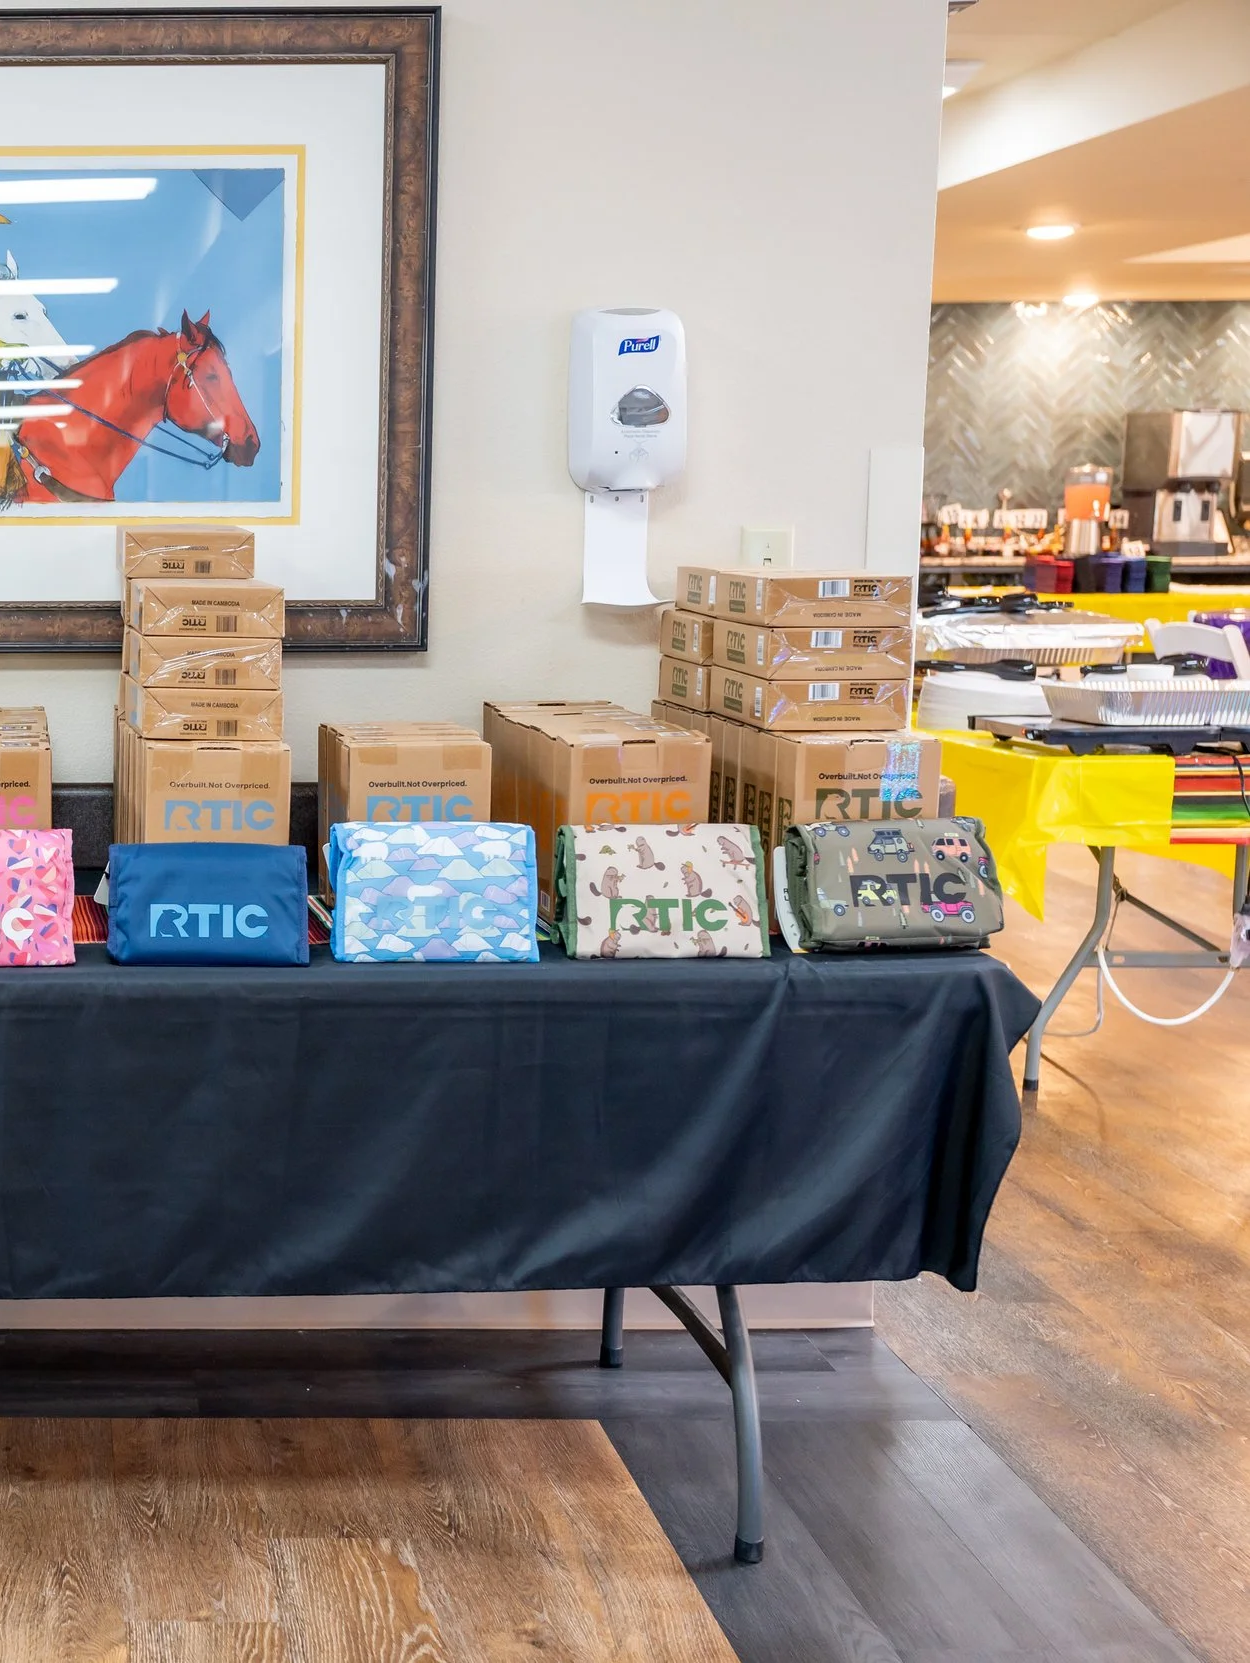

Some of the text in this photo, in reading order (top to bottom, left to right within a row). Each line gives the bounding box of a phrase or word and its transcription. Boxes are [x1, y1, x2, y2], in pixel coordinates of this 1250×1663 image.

[624, 338, 656, 352] Purell
[162, 561, 185, 570] RTIC
[853, 584, 878, 593] RTIC
[213, 600, 241, 608] CAMBODIA
[182, 618, 207, 627] RTIC
[853, 635, 877, 643] RTIC
[850, 687, 874, 695] RTIC
[182, 723, 208, 732] RTIC
[421, 780, 468, 789] Overpriced.
[642, 775, 688, 785] Overpriced.
[224, 781, 271, 790] Overpriced.
[585, 789, 693, 824] RTIC
[815, 787, 924, 820] RTIC
[366, 795, 475, 822] RTIC
[164, 799, 275, 832] RTIC
[850, 872, 967, 908] RTIC
[609, 898, 729, 933] RTIC
[150, 903, 269, 939] RTIC
